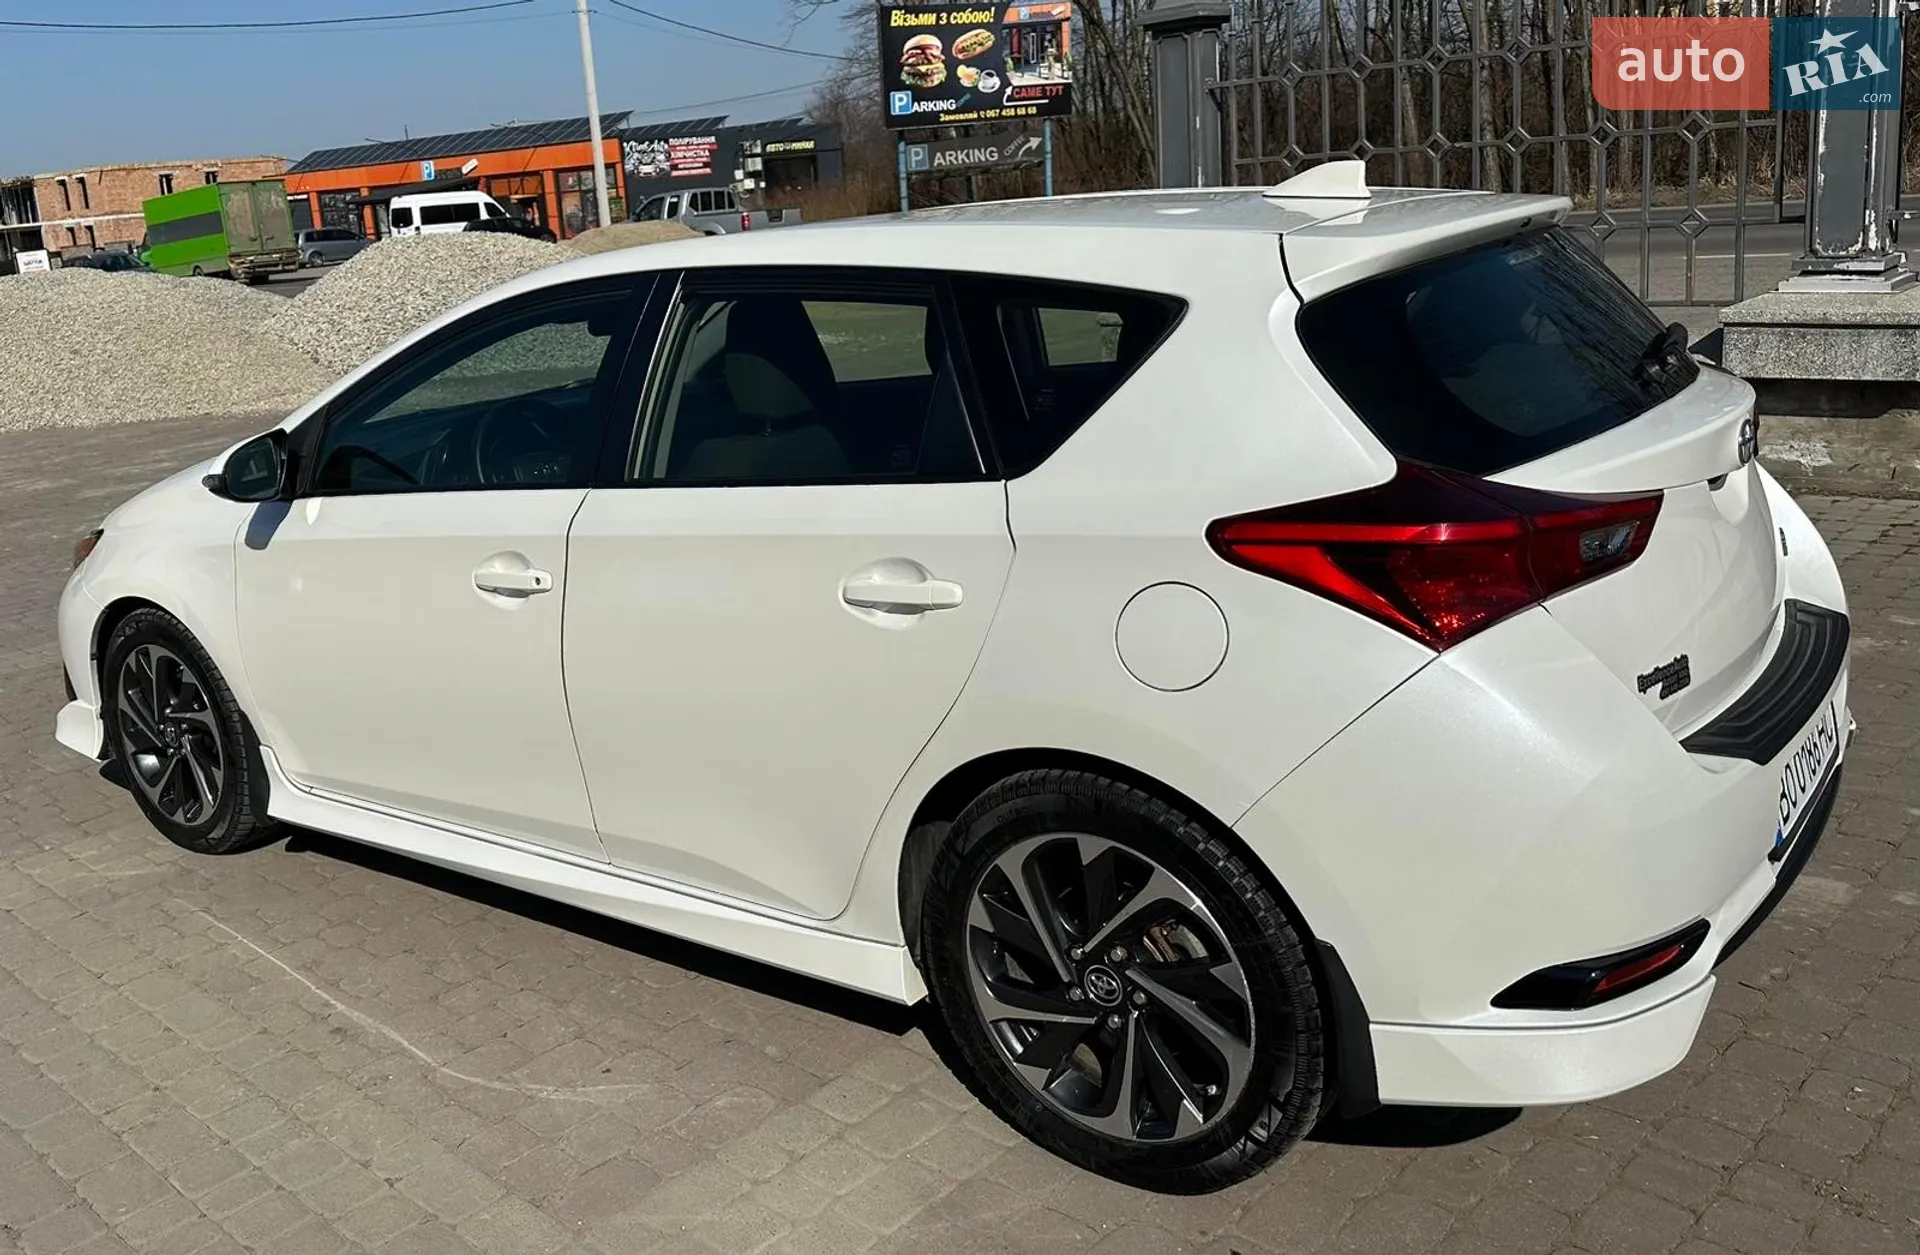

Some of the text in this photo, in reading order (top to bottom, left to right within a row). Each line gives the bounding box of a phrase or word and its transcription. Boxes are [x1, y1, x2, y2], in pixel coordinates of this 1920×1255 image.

[890, 7, 996, 27] Візьми з собою!
[1013, 85, 1064, 99] САМЕ ТУТ
